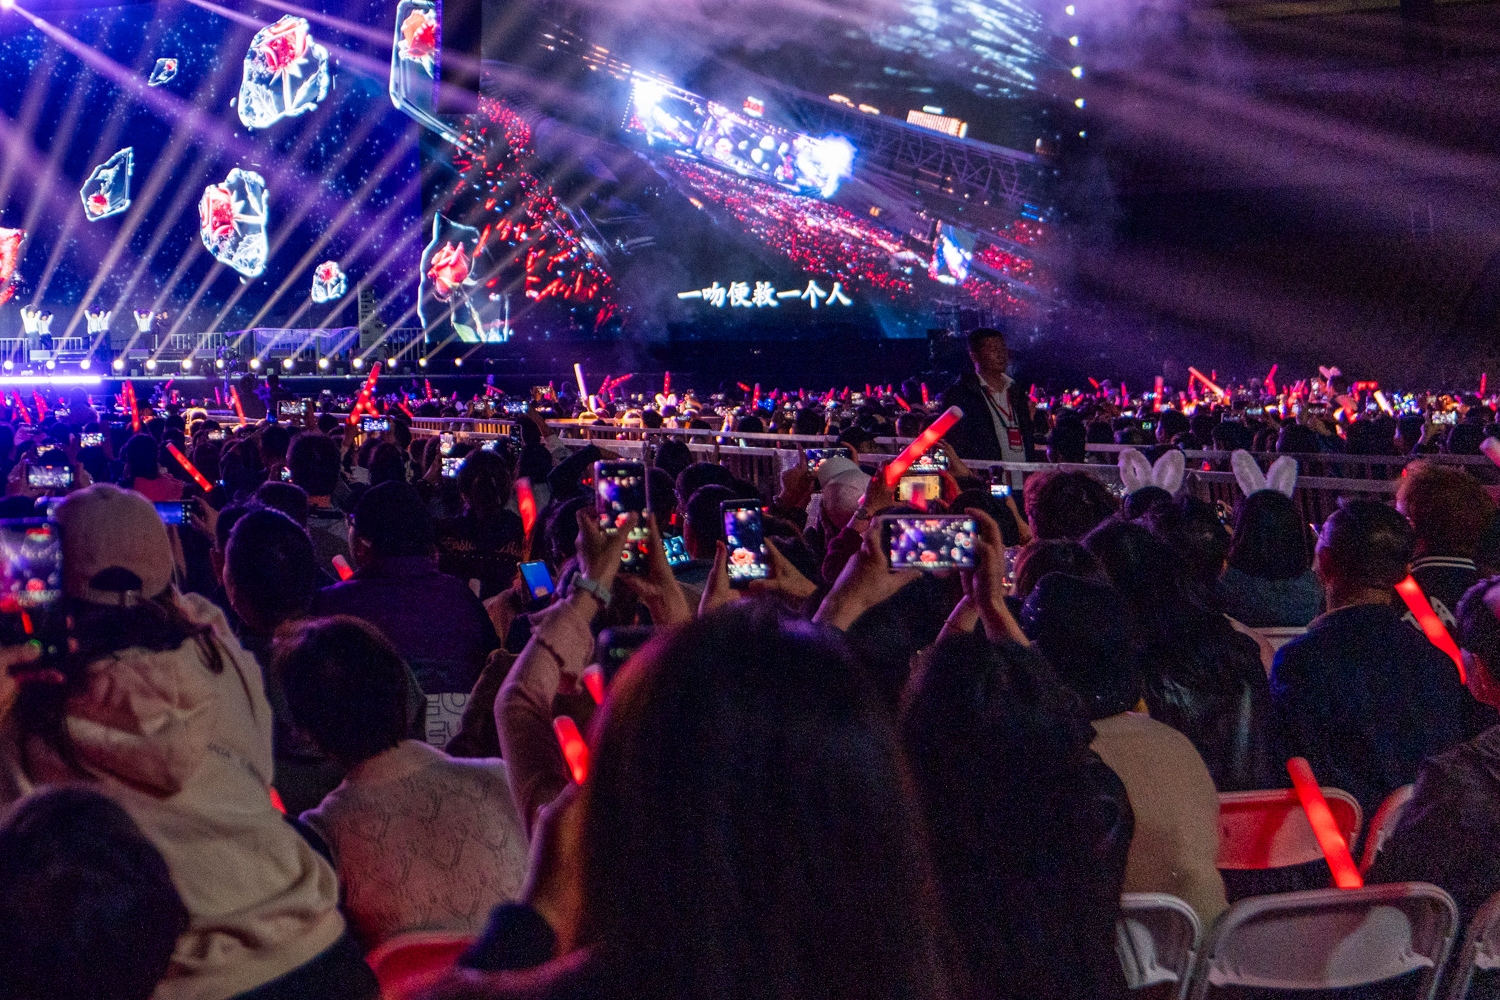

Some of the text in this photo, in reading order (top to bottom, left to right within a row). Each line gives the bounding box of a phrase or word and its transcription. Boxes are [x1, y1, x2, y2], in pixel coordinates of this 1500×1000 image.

[677, 280, 853, 309] 一吻便救一个人
